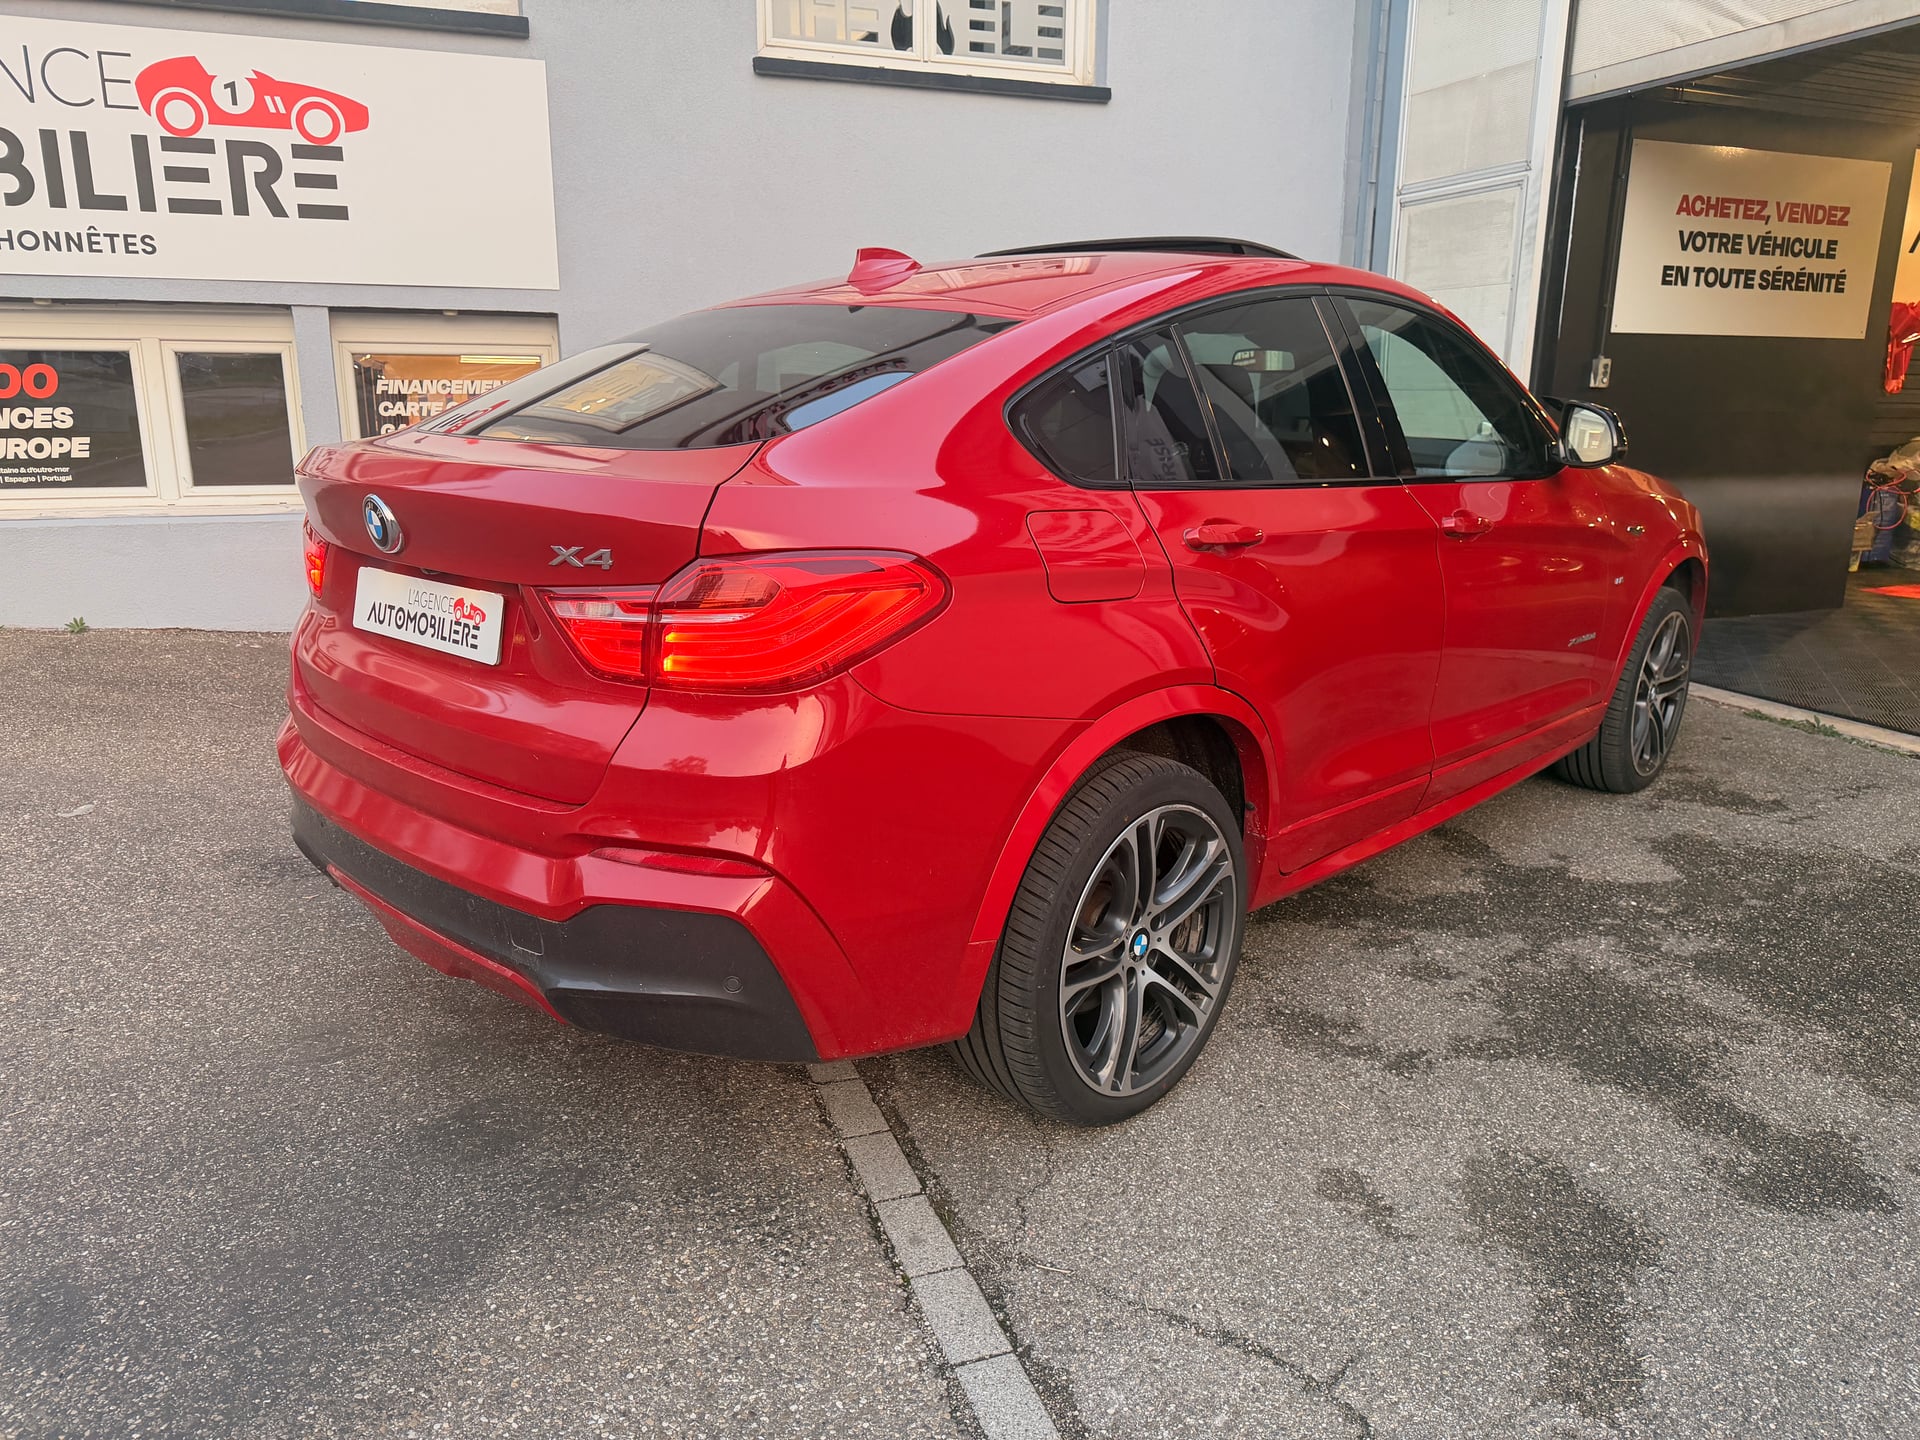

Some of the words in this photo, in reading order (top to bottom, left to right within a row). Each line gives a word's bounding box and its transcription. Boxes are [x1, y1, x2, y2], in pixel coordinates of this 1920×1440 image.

[1676, 194, 1771, 225] ACHETEZ,
[1776, 201, 1851, 227] VENDEZ
[1678, 230, 1744, 255] VOTRE
[1747, 230, 1838, 260] VÉHICULE
[1661, 265, 1690, 287] EN
[1693, 266, 1755, 290] TOUTE
[1758, 265, 1847, 293] SÉRÉNITÉ
[378, 401, 442, 417] CARTE
[4, 476, 36, 484] Espagne
[42, 475, 73, 483] Portugal
[548, 545, 614, 570] X4
[408, 587, 455, 615] L'AGENCE
[367, 601, 480, 650] AUTOMOBILIERE
